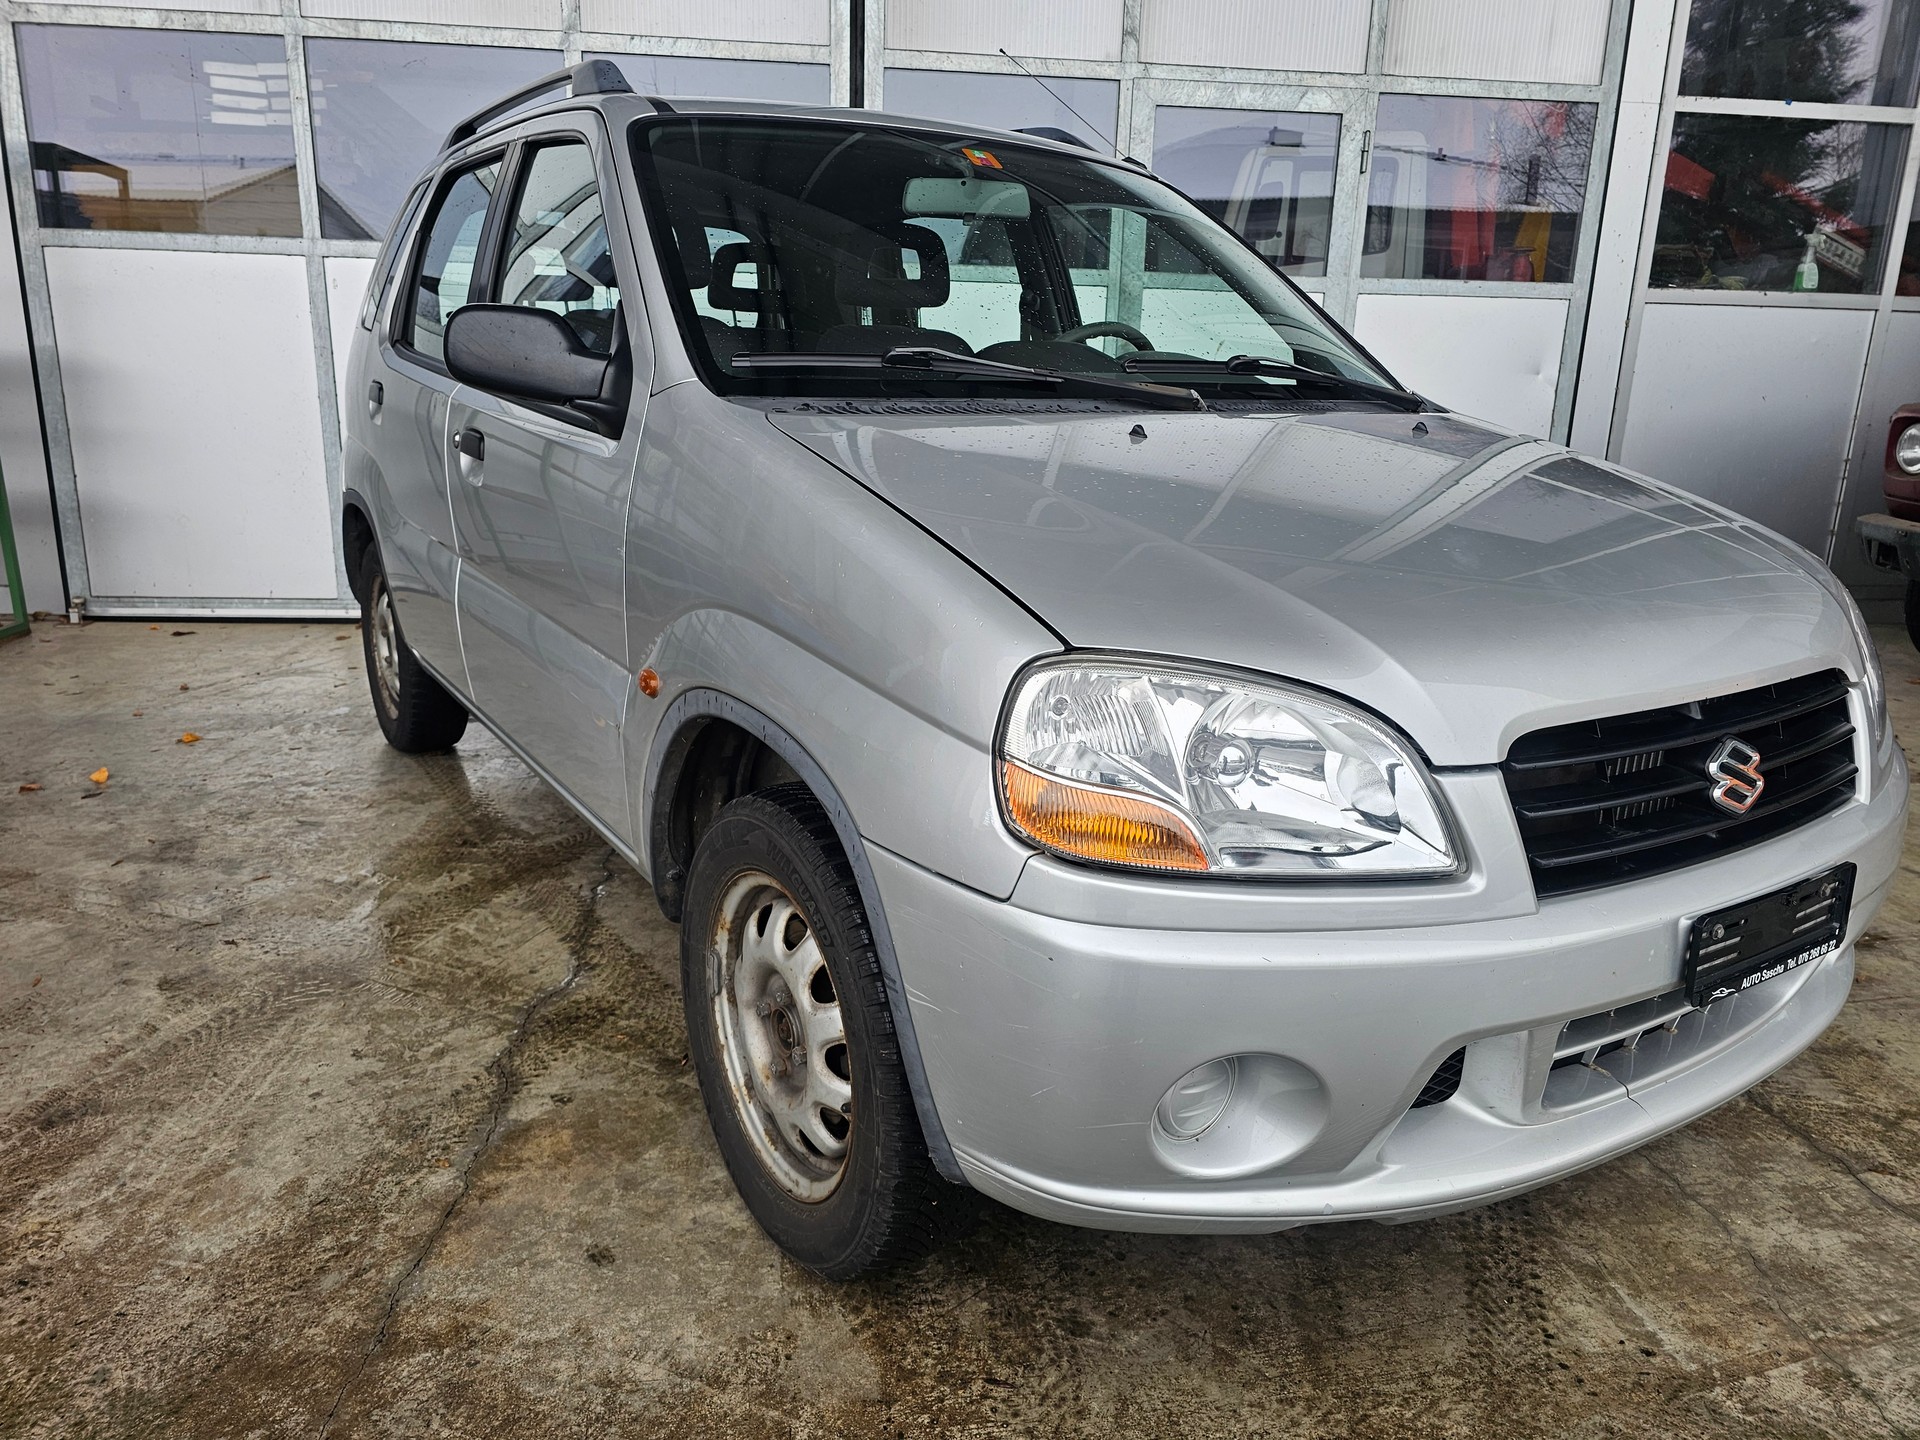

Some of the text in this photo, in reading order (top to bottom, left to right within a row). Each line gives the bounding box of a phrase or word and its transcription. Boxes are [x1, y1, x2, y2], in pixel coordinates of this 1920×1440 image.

[1741, 972, 1761, 989] AUTO
[1762, 964, 1784, 981] Sascha
[1787, 957, 1797, 969] Tel.
[1798, 952, 1809, 964] 076
[1828, 939, 1836, 951] 22
